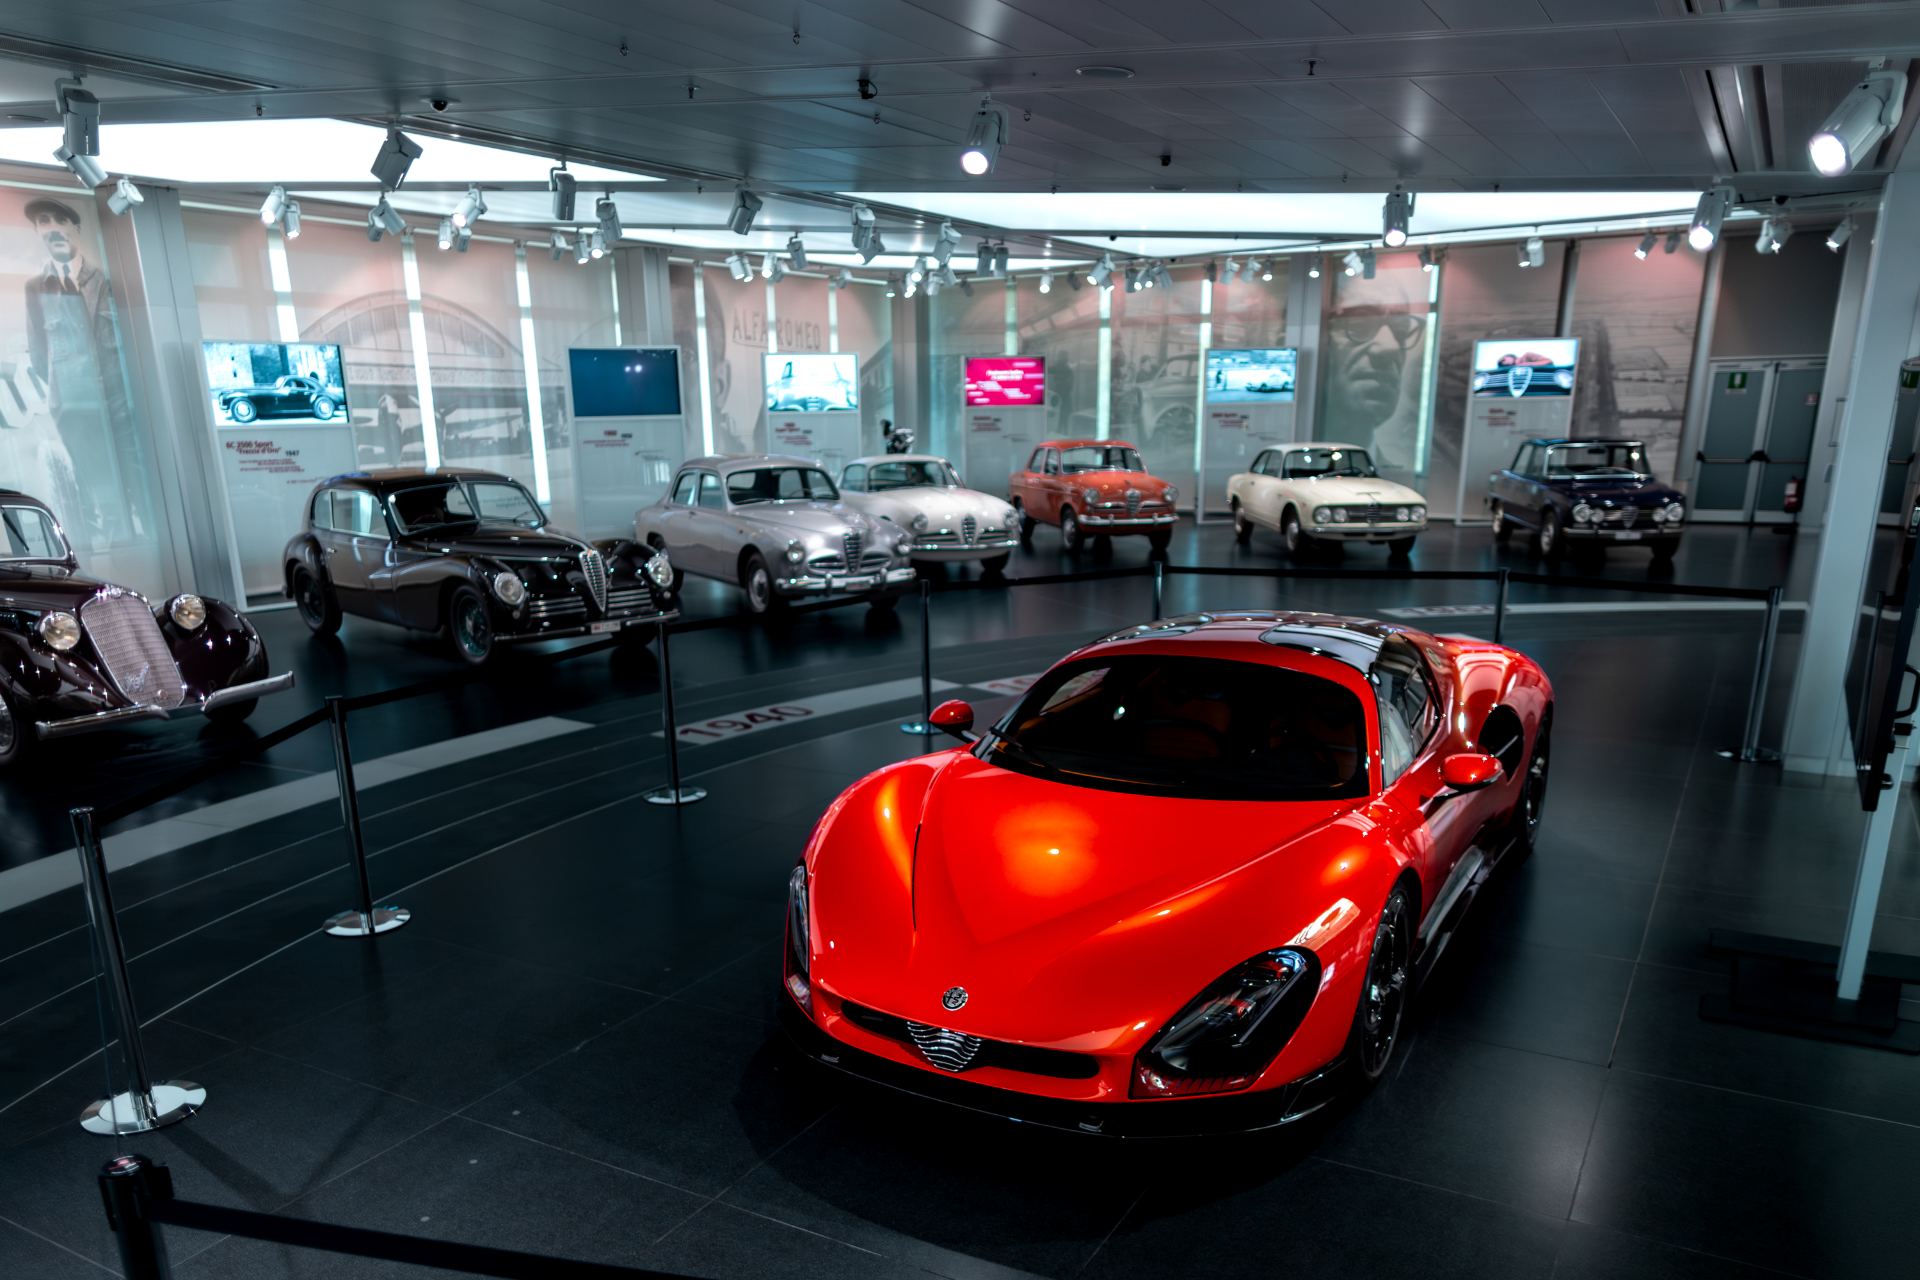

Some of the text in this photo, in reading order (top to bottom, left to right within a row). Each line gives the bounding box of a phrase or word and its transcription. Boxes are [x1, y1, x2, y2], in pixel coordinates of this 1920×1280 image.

[732, 308, 821, 351] ALFA ROMEO
[679, 705, 814, 738] 1940
